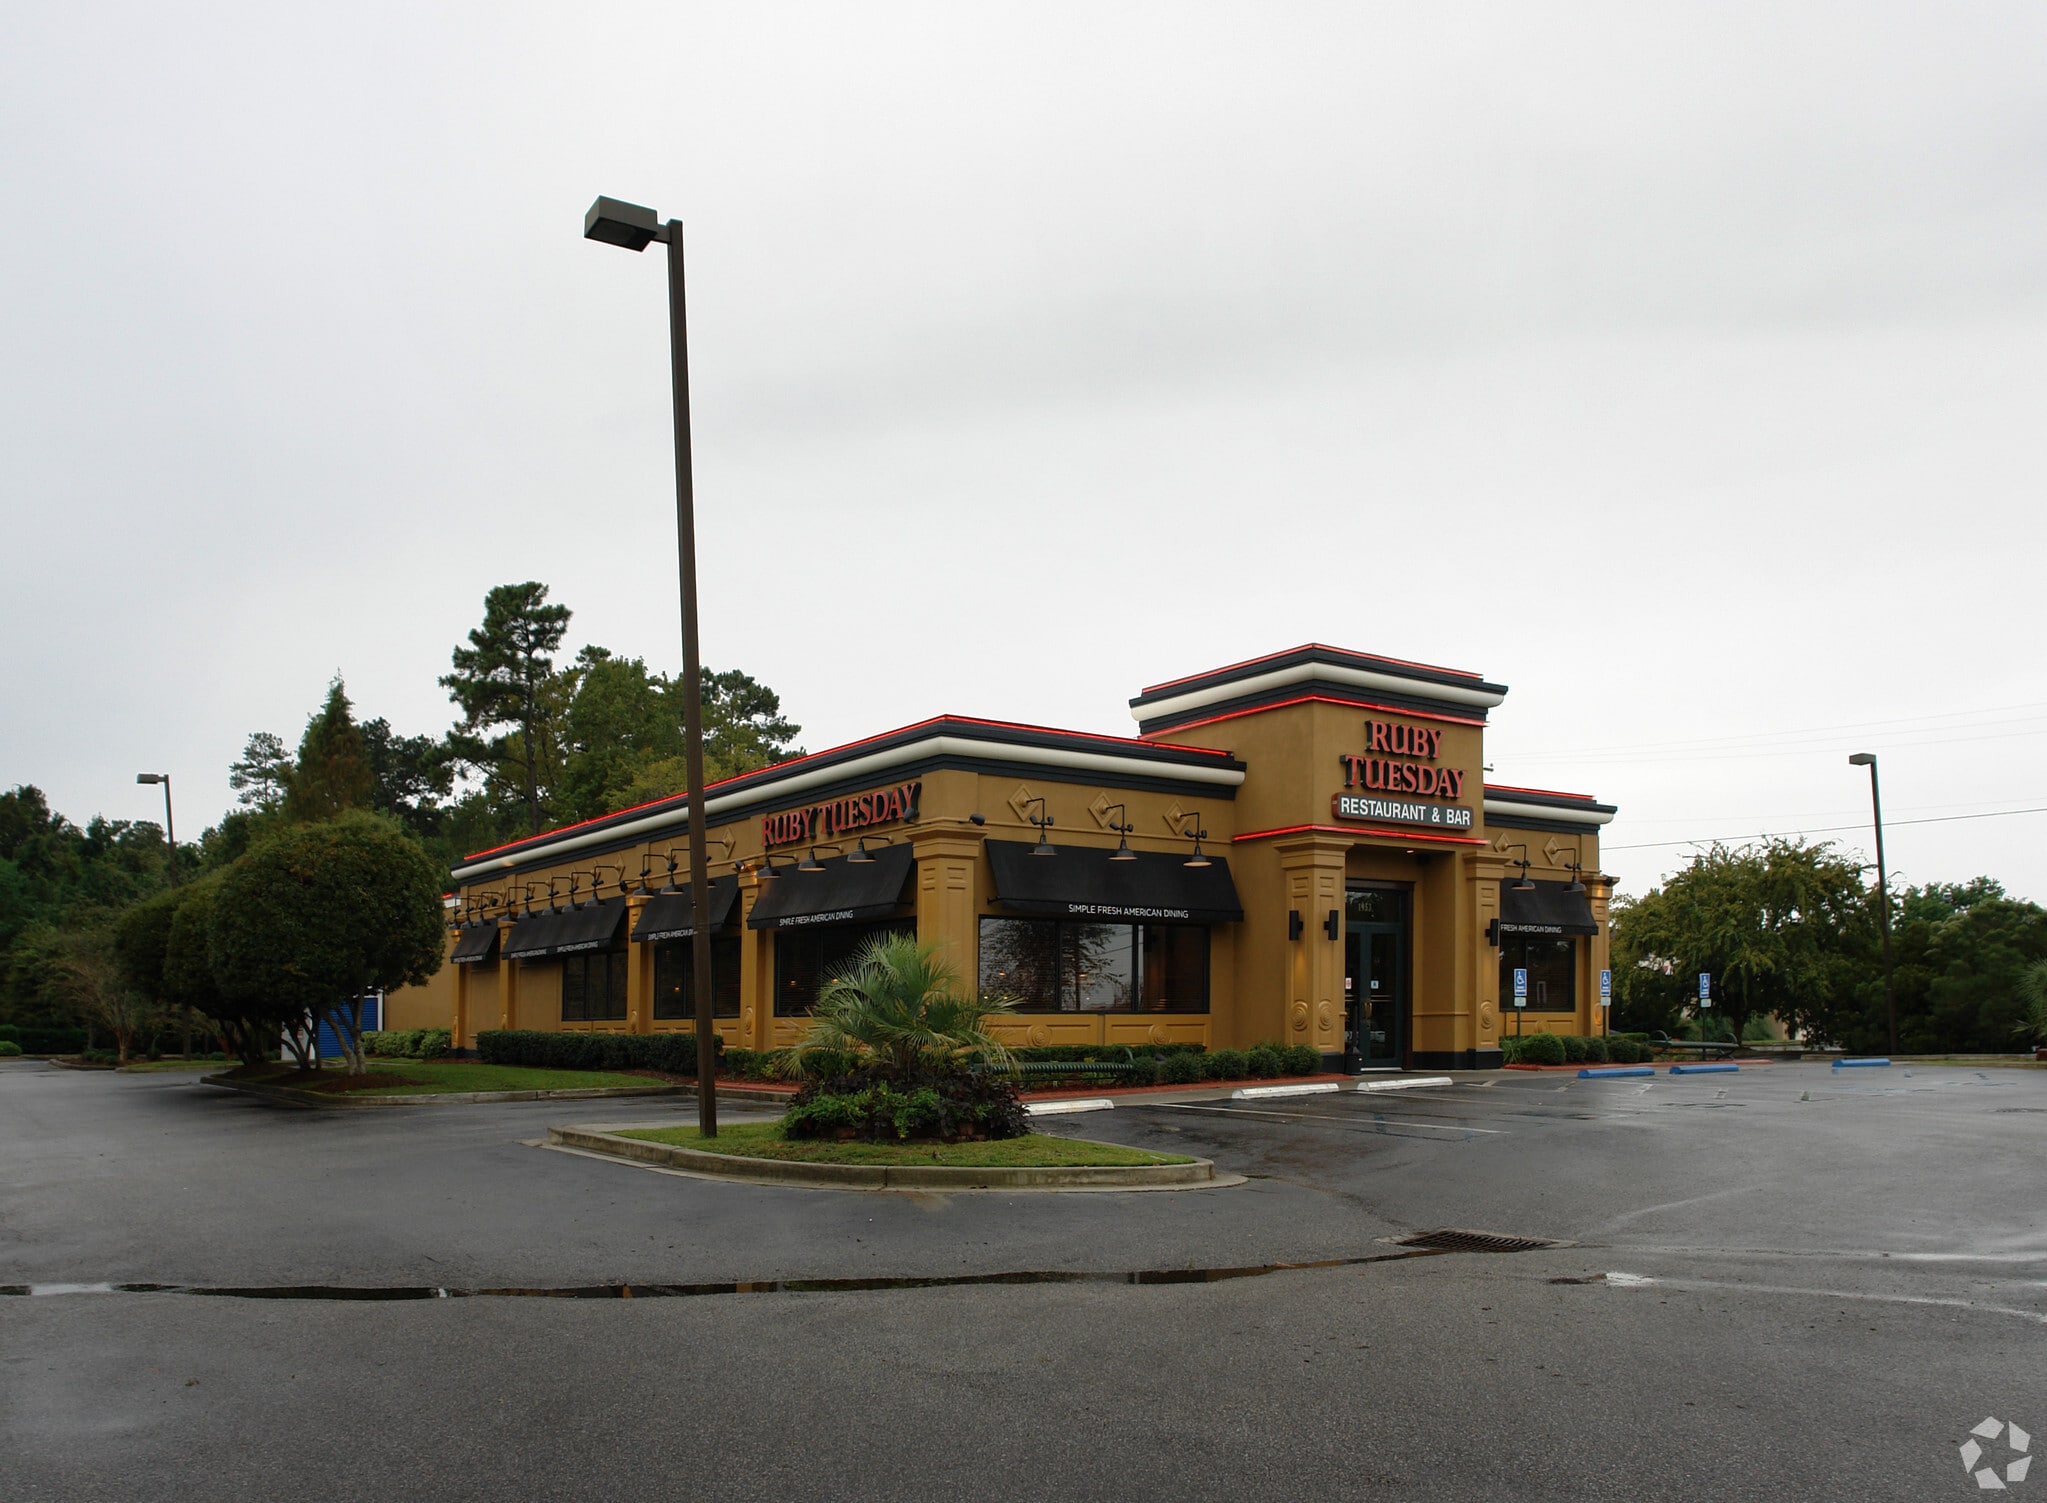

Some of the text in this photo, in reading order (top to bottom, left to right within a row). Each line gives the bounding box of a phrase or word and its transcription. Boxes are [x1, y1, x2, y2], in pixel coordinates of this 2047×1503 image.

[1367, 720, 1445, 759] RUBY
[1342, 755, 1467, 798] TUESDAY
[761, 782, 918, 847] RUBY TUESDAY
[1341, 797, 1471, 826] RESTAURANT & BAR
[1068, 904, 1189, 919] SIMPLE FRESH AMERICAN DINING
[1500, 923, 1518, 932] FRESH
[1518, 924, 1544, 933] AMERICAN
